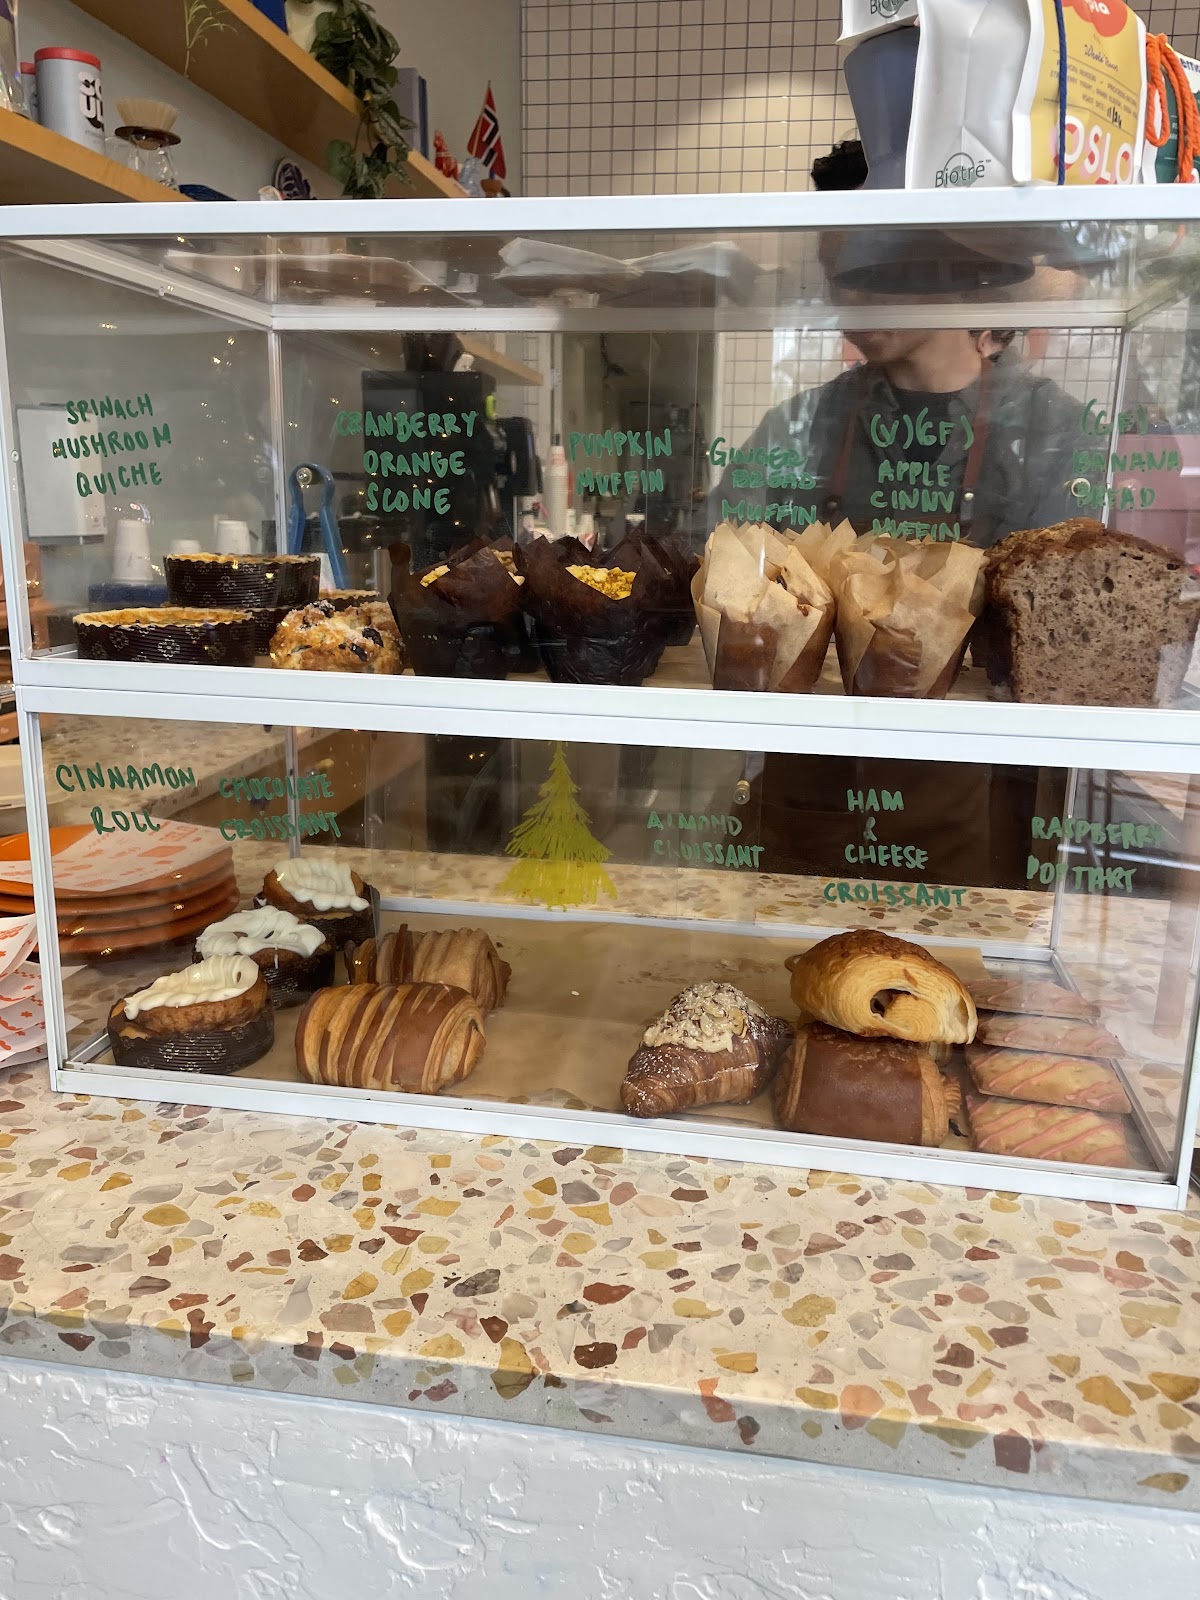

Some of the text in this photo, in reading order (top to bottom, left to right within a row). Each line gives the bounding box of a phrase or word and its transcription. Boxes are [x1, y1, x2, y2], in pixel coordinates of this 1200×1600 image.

[1055, 114, 1134, 185] OSLO
[66, 393, 154, 424] SPINACH
[336, 411, 478, 442] CRANBERRY
[52, 423, 172, 459] MUSHROOM
[568, 428, 673, 463] PUMPKIN
[363, 450, 467, 478] ORANGE
[877, 459, 951, 487] APPLE
[1072, 450, 1181, 474] BANANA
[76, 462, 163, 497] QUICHE
[575, 467, 665, 496] MUFFIN
[732, 469, 817, 490] BREAD
[366, 482, 451, 514] SCONE
[1076, 483, 1157, 510] BREAD
[721, 499, 817, 526] MUFFIN
[872, 517, 961, 542] MUFFIN
[55, 762, 196, 792] CINNAMON
[218, 773, 335, 802] CHOCOLATE
[846, 788, 904, 813] HAM
[90, 805, 161, 835] ROLL
[862, 816, 878, 842] &
[843, 844, 929, 870] CHEESE
[1072, 866, 1138, 893] TART
[824, 882, 967, 907] CROISSANT
